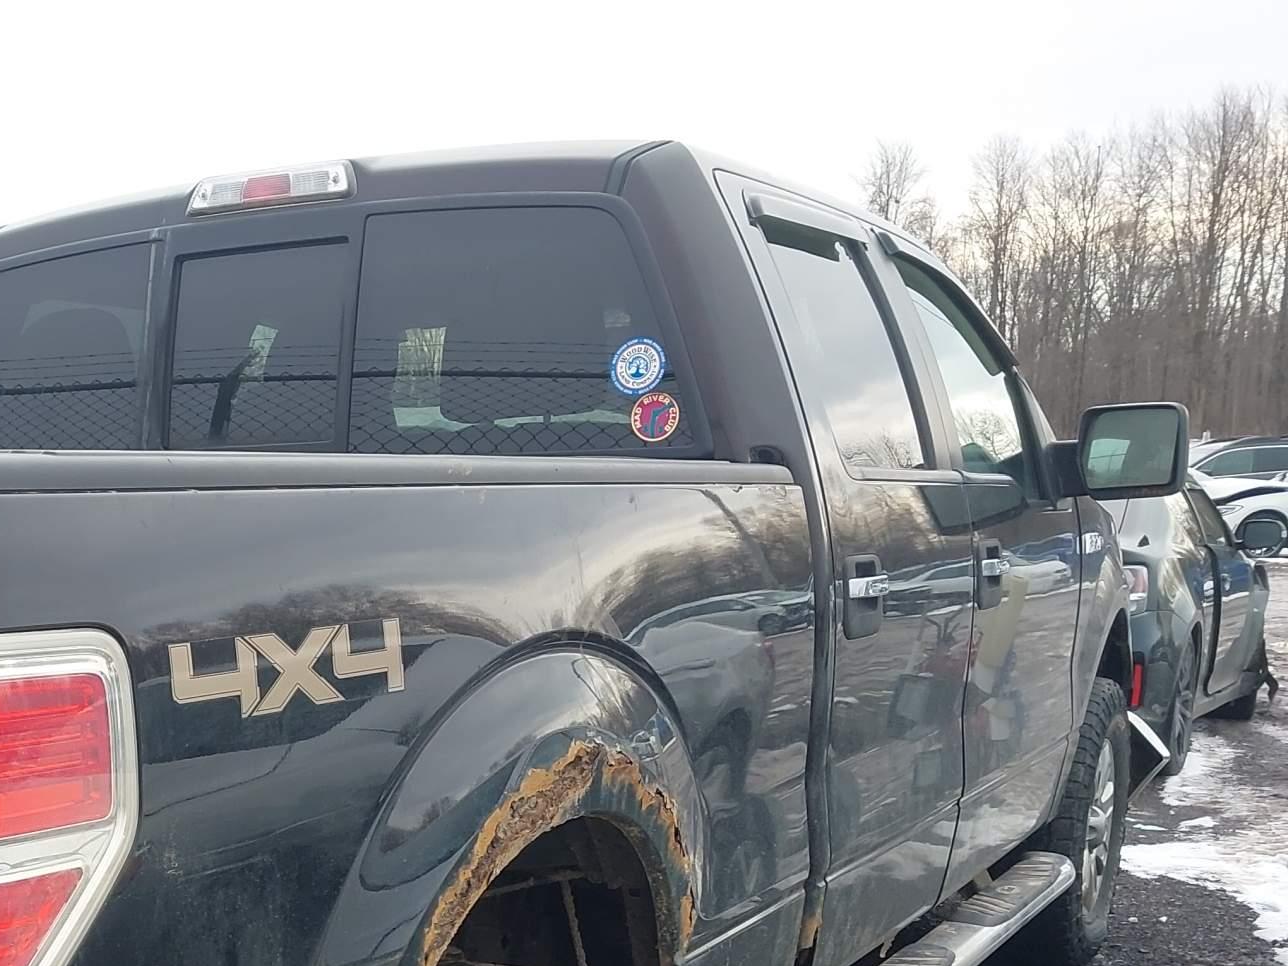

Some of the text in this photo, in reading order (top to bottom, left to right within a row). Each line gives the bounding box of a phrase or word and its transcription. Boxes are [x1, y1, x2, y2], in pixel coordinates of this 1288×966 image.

[634, 394, 676, 432] MAD RIVER CLUB
[168, 618, 405, 718] 4X4
